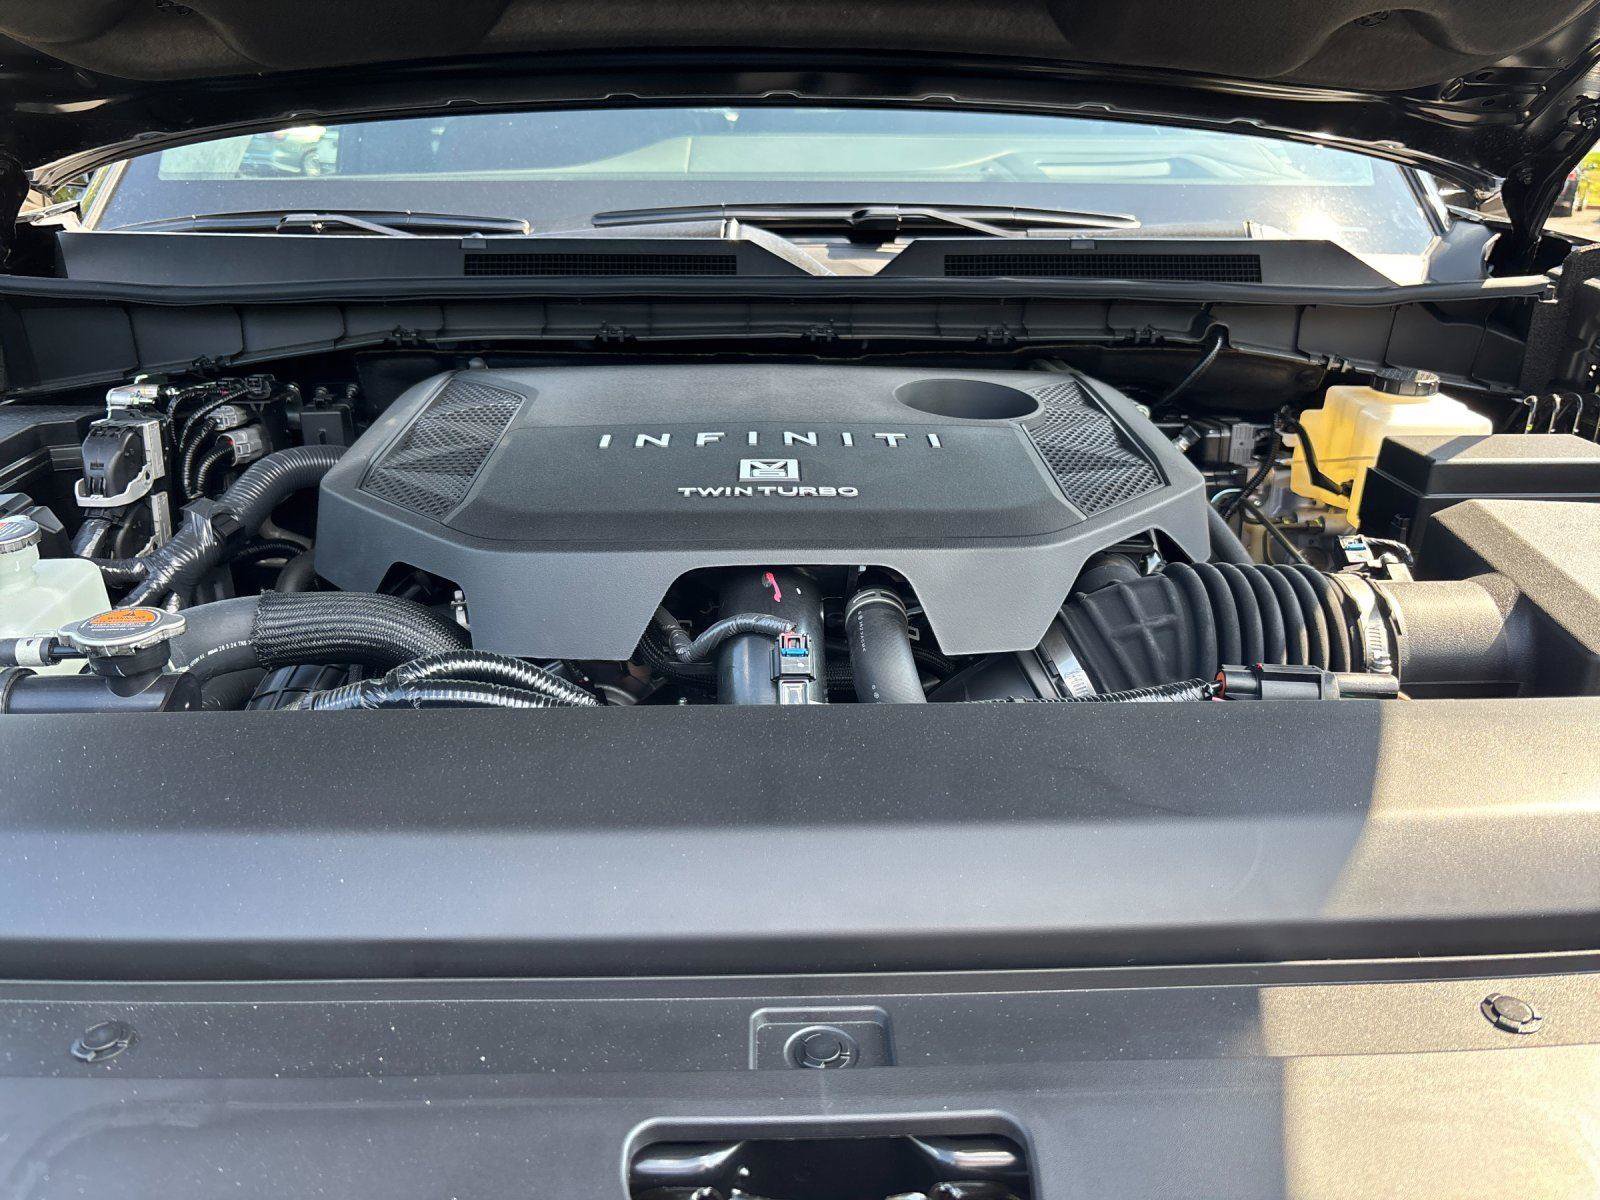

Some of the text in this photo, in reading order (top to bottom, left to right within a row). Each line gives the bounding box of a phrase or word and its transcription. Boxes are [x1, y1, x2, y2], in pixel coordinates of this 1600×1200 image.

[599, 431, 942, 448] INFINITI
[677, 486, 859, 497] TWIN TURBO
